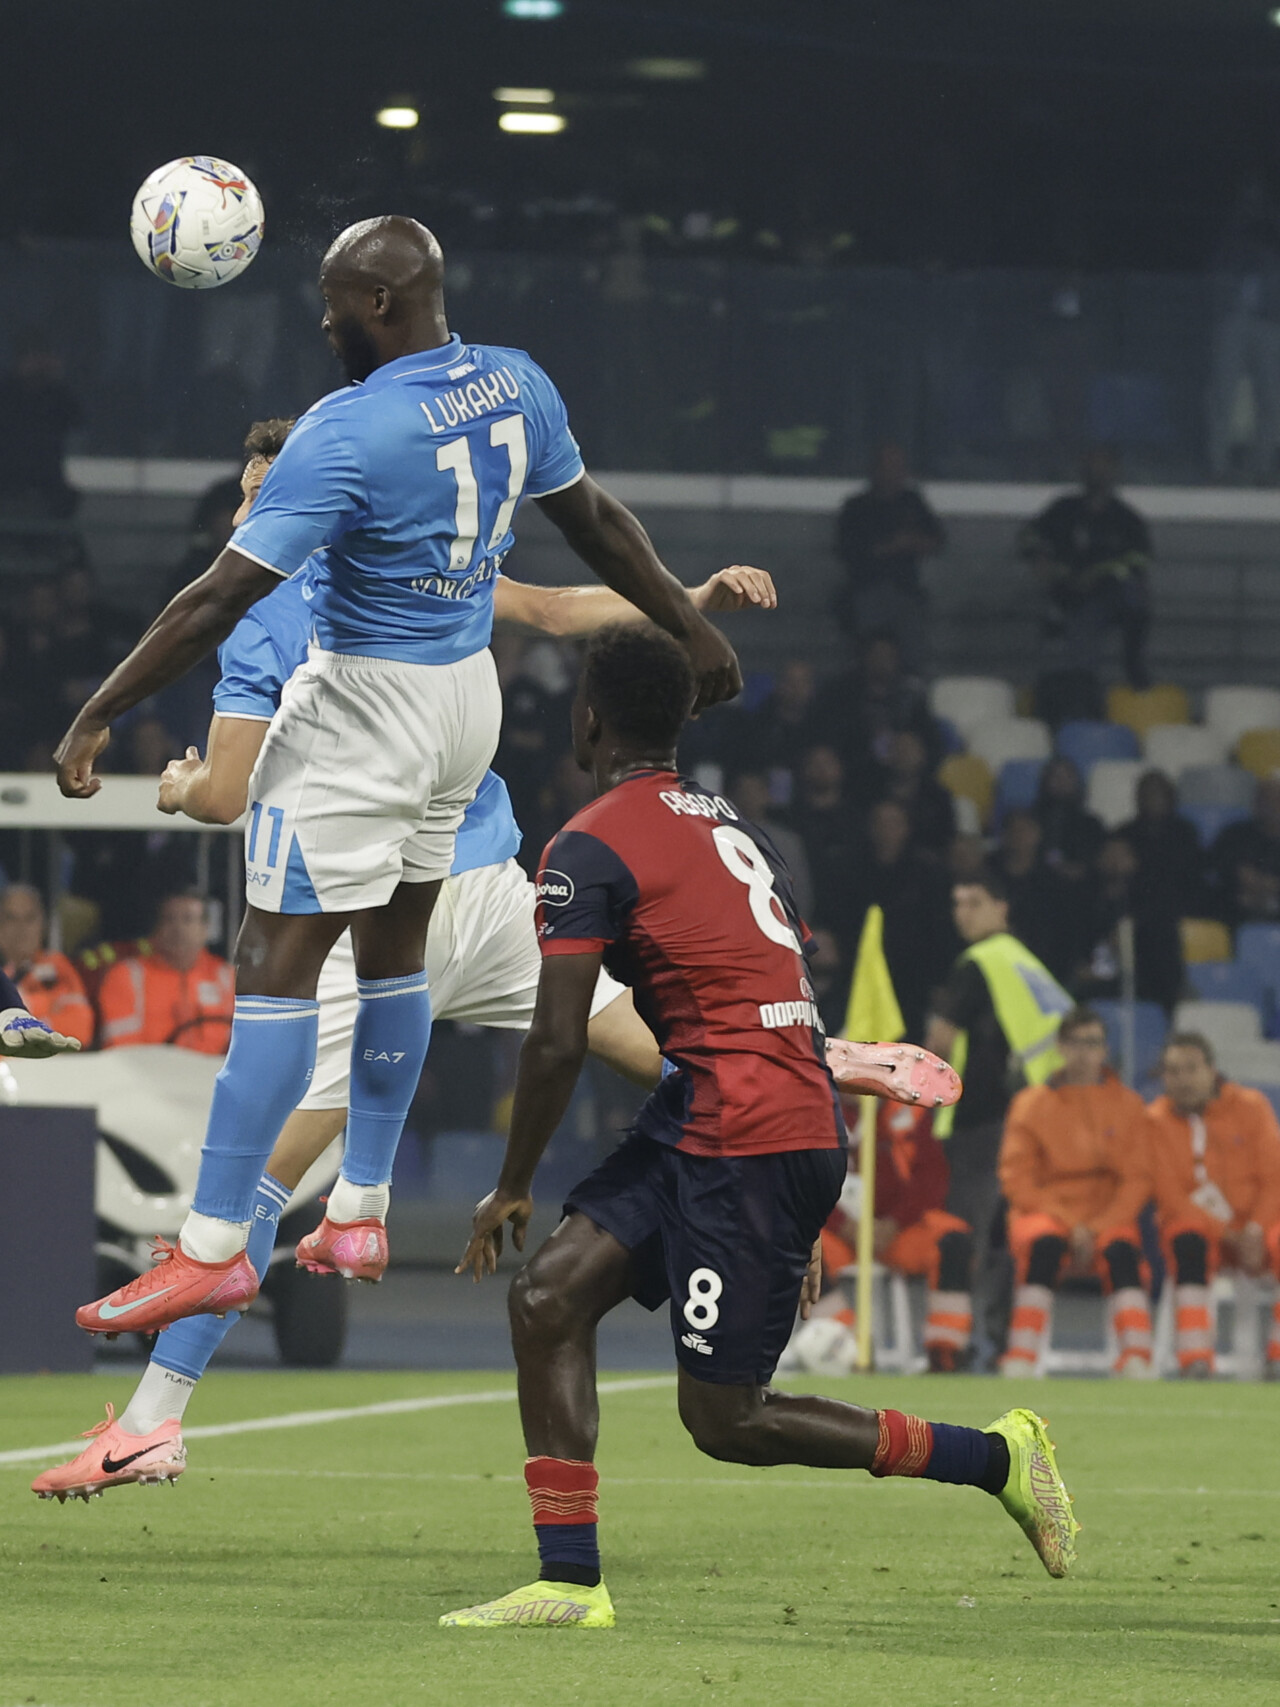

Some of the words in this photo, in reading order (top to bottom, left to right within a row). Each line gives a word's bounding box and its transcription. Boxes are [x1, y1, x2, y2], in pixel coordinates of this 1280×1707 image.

[420, 366, 520, 434] LUKAKU
[248, 800, 285, 869] 11
[247, 868, 272, 887] EA7
[712, 824, 802, 956] 8
[363, 1049, 406, 1063] EA7
[254, 1204, 279, 1224] EA
[683, 1267, 723, 1331] 8
[164, 1372, 195, 1388] PLAYM
